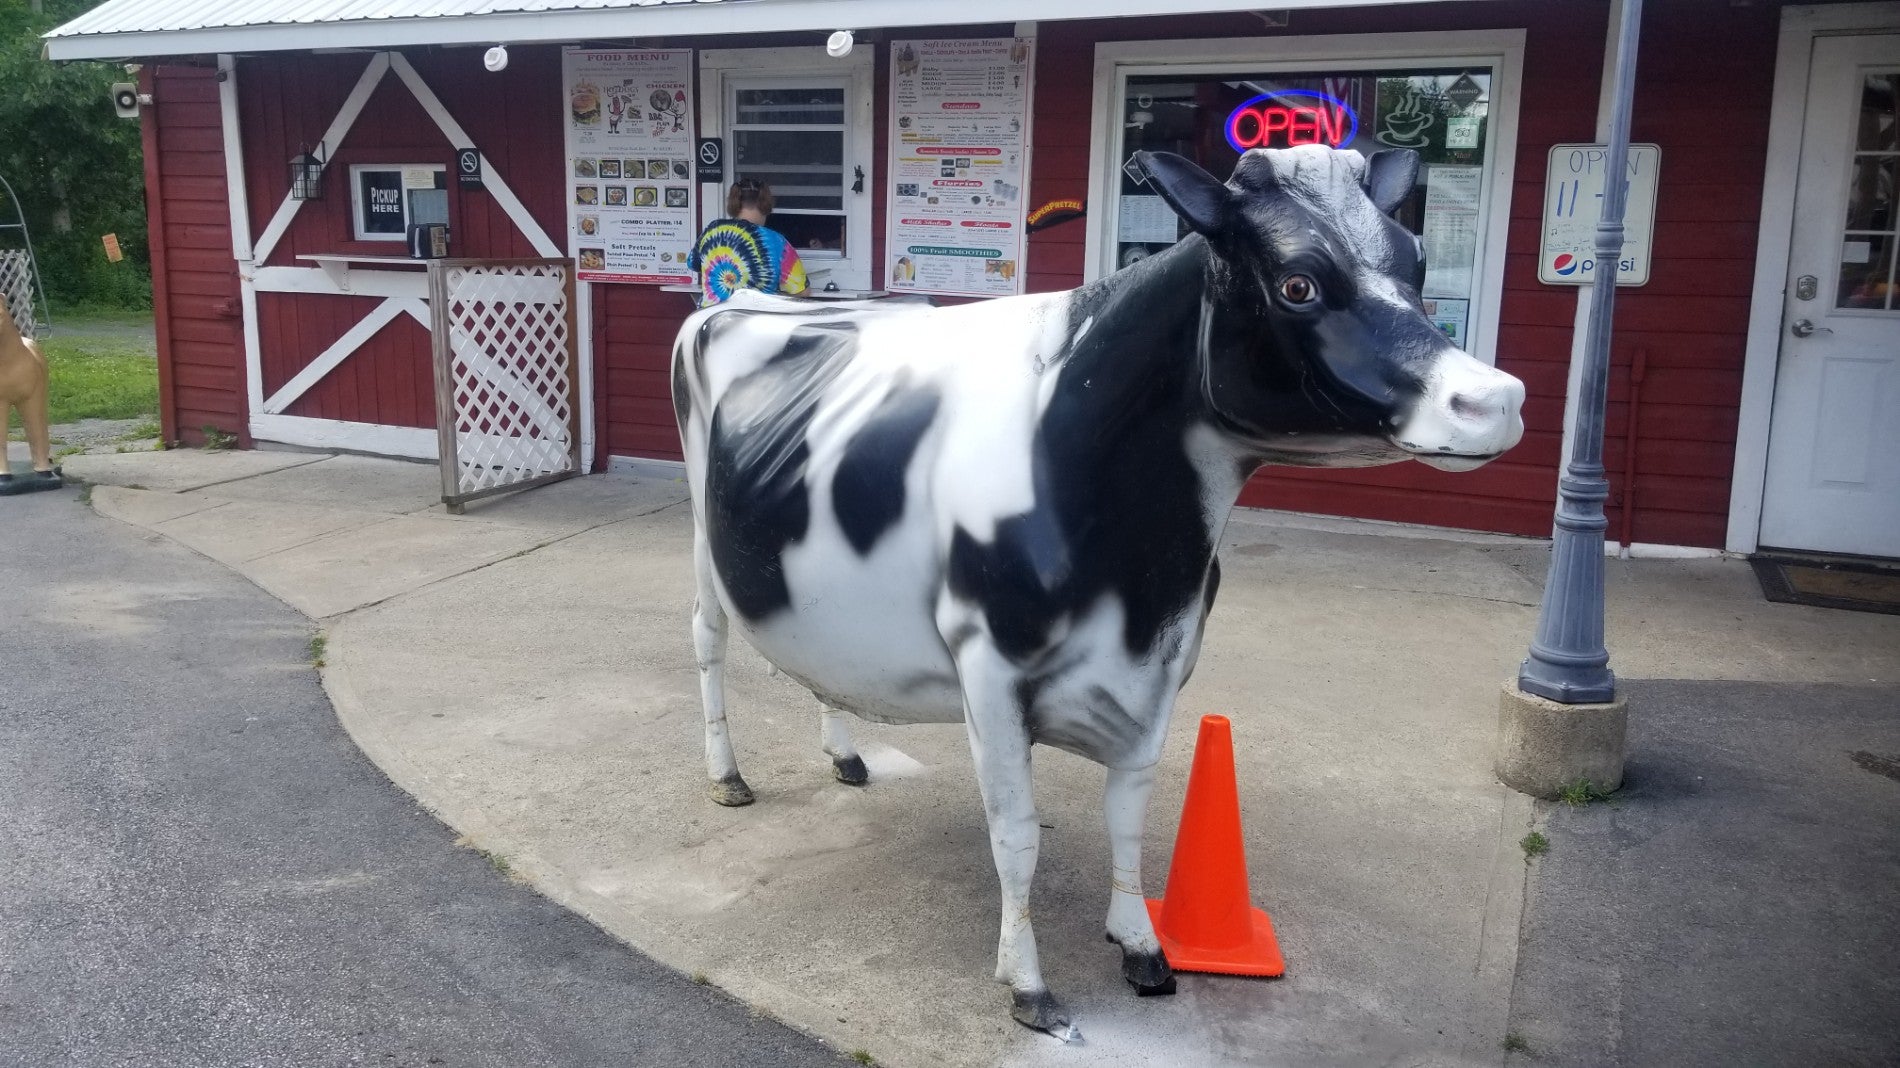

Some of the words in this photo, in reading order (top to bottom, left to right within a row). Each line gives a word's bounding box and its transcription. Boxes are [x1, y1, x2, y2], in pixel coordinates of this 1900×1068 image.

[587, 54, 622, 62] FOOD
[627, 53, 670, 61] MENU
[1233, 105, 1343, 148] OPEN
[370, 187, 399, 204] PICKUP
[372, 204, 400, 213] HERE
[629, 243, 656, 251] Pretzels
[929, 247, 947, 255] Fruit
[948, 249, 999, 257] SMOOTHIES
[1581, 257, 1635, 274] psi
